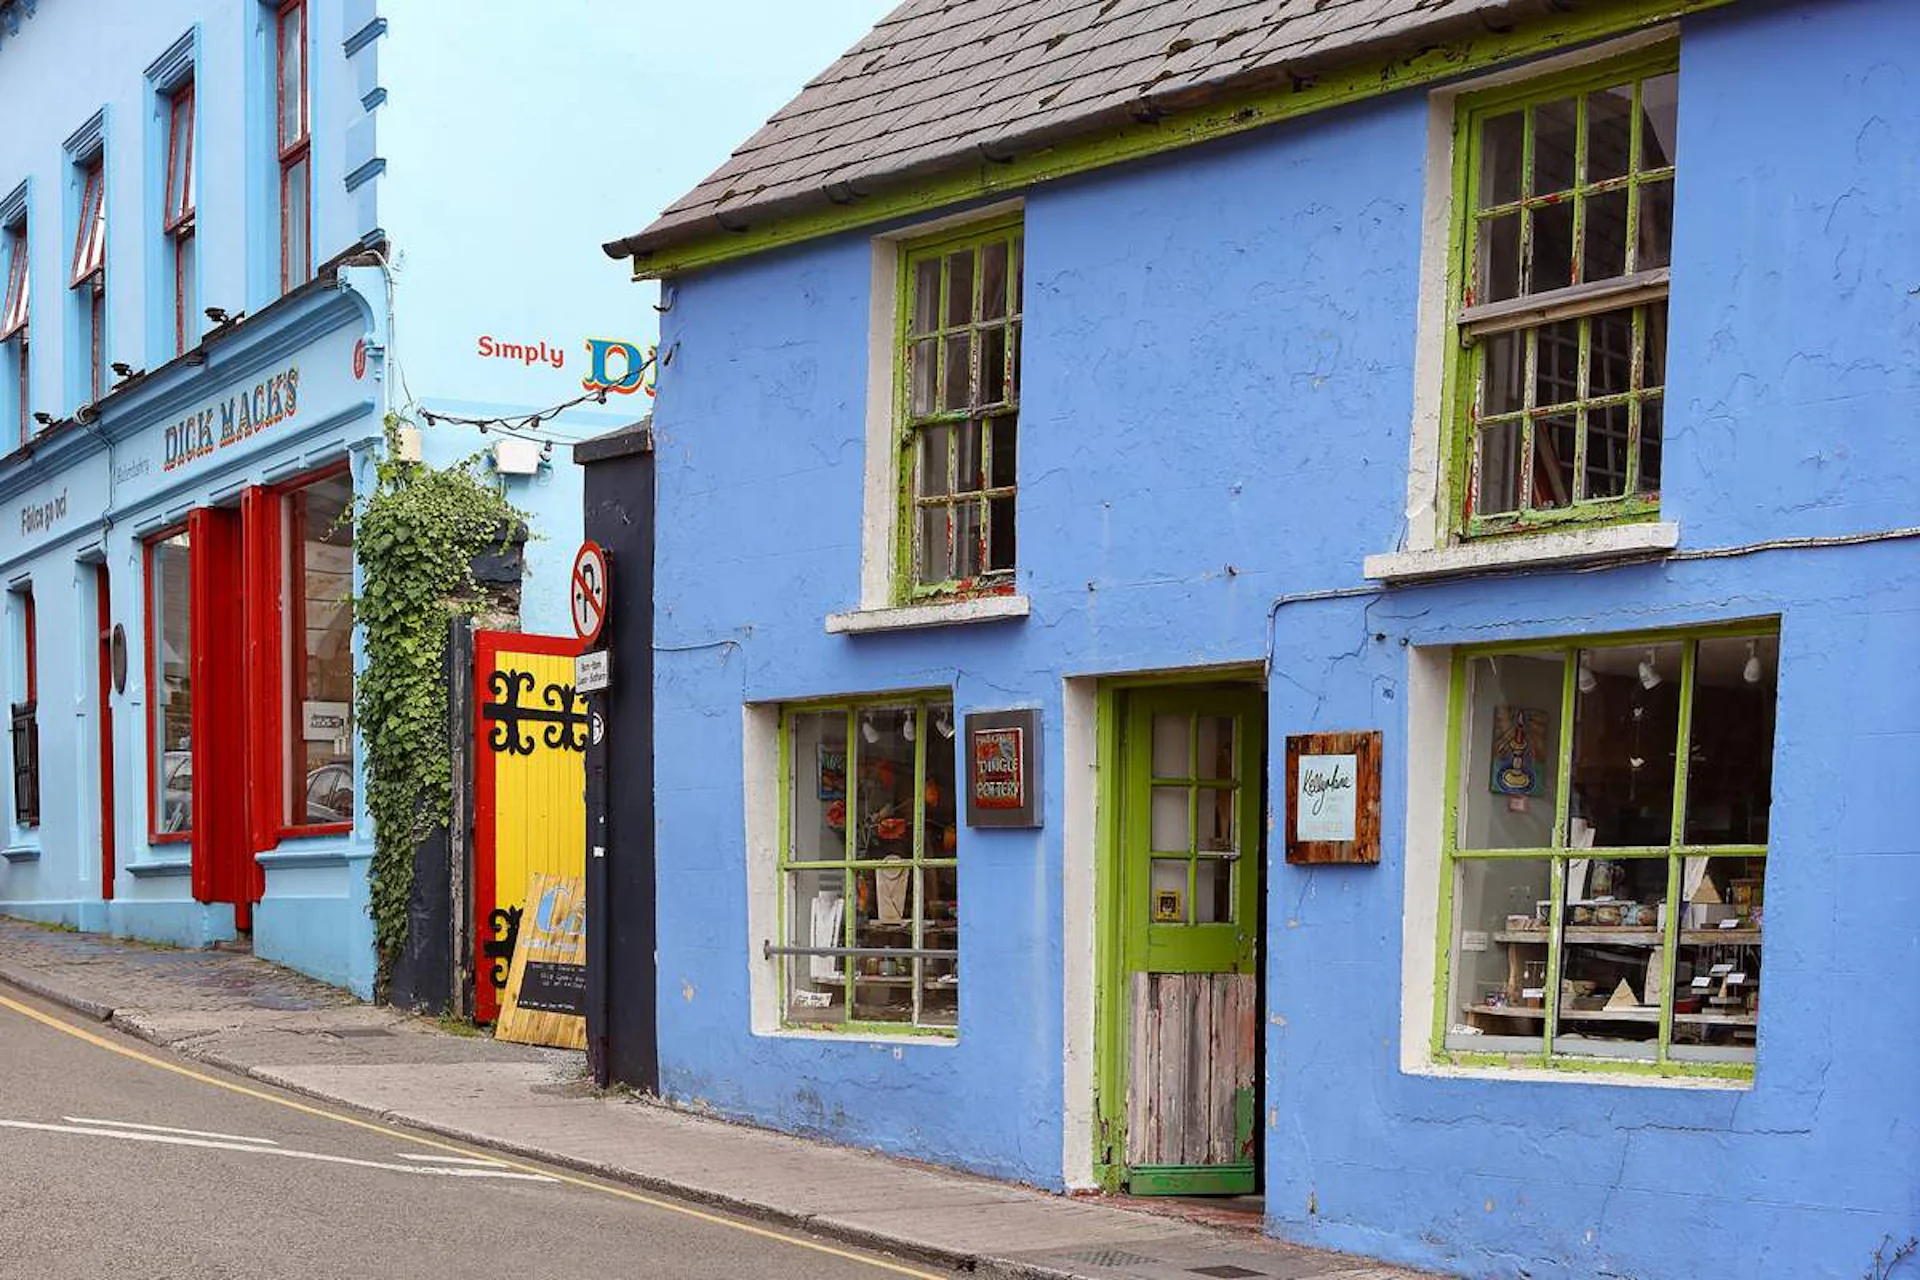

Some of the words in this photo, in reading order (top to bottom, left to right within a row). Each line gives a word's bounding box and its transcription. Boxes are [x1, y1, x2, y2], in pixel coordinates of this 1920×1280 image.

[477, 335, 564, 368] Simply
[164, 407, 214, 471] DICK
[220, 366, 299, 448] MACK'S
[979, 757, 1019, 773] DINGLE
[976, 780, 1020, 799] POTTERY
